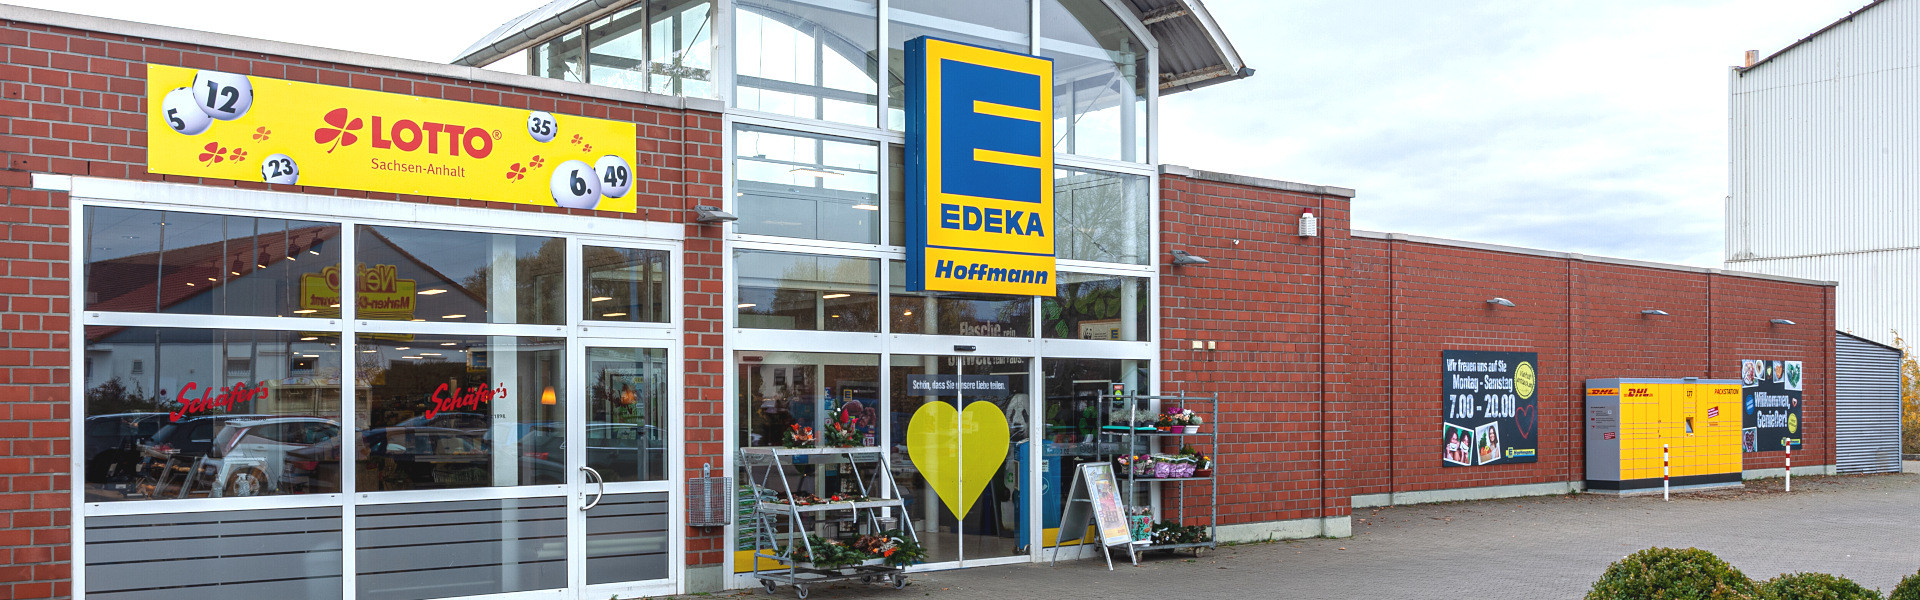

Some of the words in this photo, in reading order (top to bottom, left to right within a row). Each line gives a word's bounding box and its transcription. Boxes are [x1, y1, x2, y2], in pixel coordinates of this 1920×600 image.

[207, 80, 240, 114] 12
[167, 108, 185, 130] 5
[531, 117, 551, 136] 35
[940, 58, 1041, 204] E
[268, 158, 293, 178] 23
[371, 158, 465, 178] Sachsen-Anhalt
[604, 166, 627, 187] 49
[941, 203, 1045, 237] EDEKA
[935, 259, 1048, 285] Hoffmann
[960, 320, 1001, 337] Flasche
[1446, 359, 1457, 371] Wir
[1458, 359, 1476, 372] freuen
[1477, 361, 1487, 372] uns
[1488, 360, 1498, 372] auf
[1498, 360, 1507, 372] Sie
[912, 380, 931, 390] Schön,
[932, 380, 945, 390] dass
[946, 380, 955, 390] Sie
[976, 380, 990, 390] Liebe
[1452, 374, 1479, 393] Montag
[1484, 374, 1513, 393] Samstag
[1628, 388, 1649, 397] DHL
[169, 381, 268, 422] Schäfer's
[425, 382, 507, 419] Schäfer's
[1449, 394, 1474, 419] 7.00
[1484, 394, 1516, 418] 20.00
